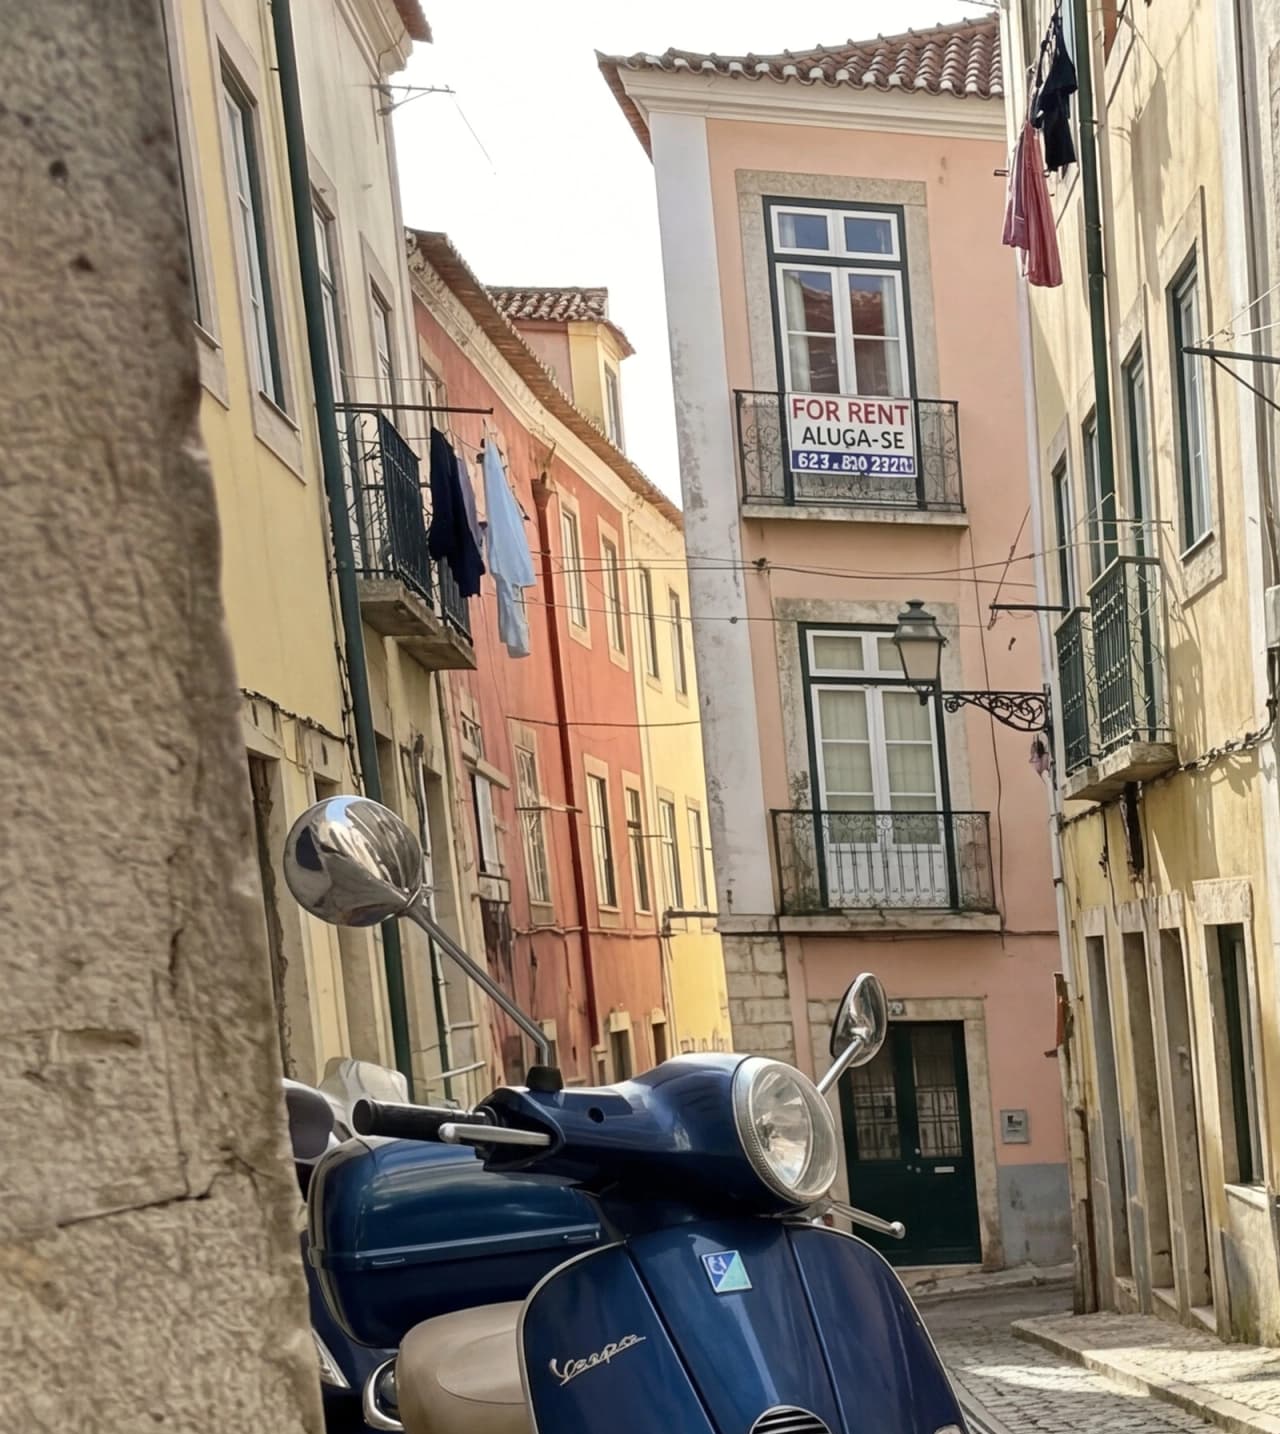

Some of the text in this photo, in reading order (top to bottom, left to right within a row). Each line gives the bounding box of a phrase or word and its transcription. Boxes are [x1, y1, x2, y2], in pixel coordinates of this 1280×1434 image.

[792, 398, 909, 426] FOR RENT
[549, 1333, 647, 1386] Vespa
